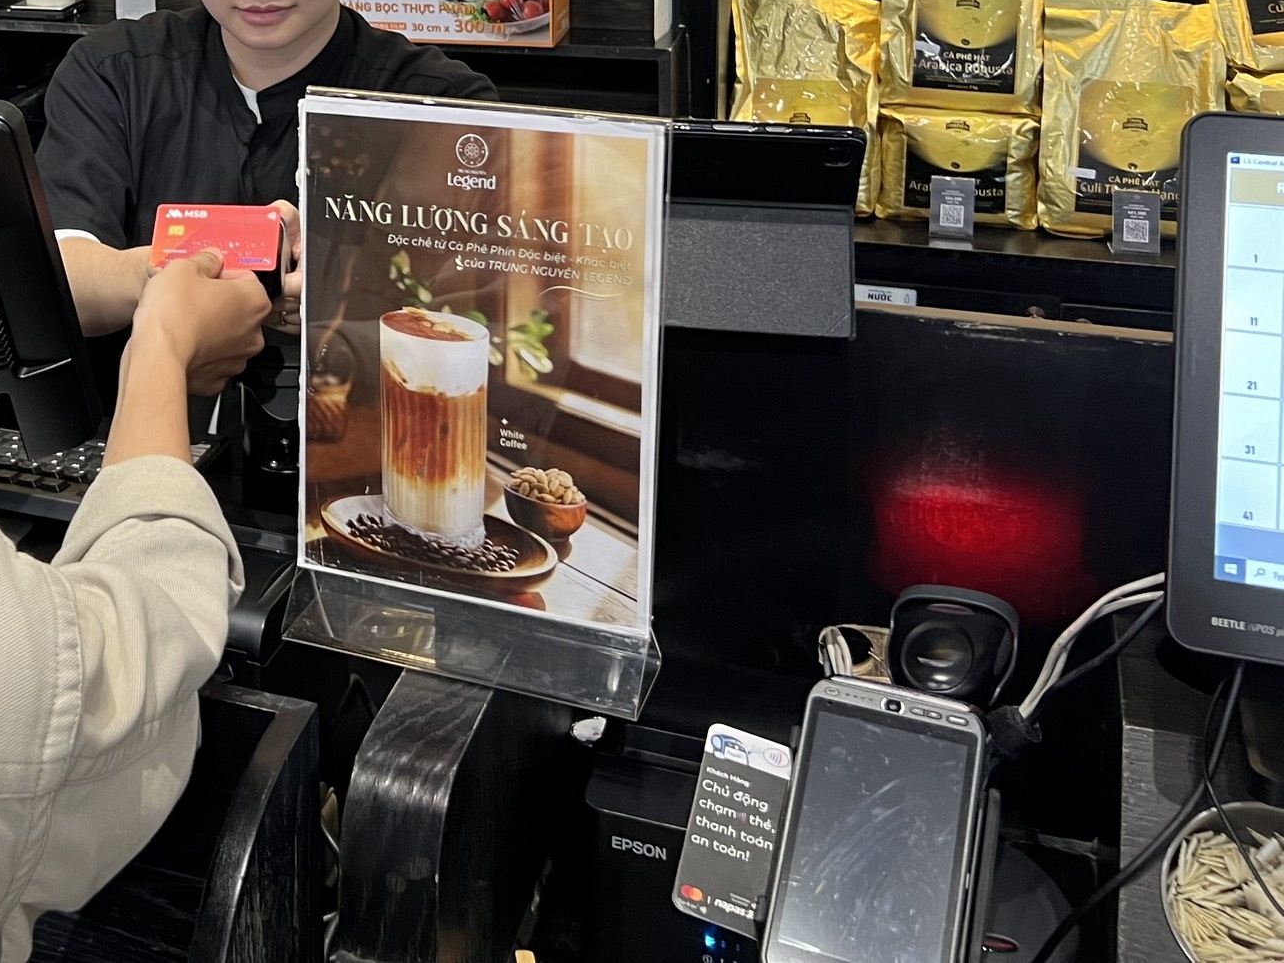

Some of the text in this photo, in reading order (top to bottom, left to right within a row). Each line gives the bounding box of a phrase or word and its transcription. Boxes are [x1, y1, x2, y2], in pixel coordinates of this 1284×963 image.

[375, 3, 399, 15] BỌC
[402, 2, 435, 15] THỰC
[411, 23, 424, 32] 30
[454, 20, 484, 33] 300
[490, 23, 506, 34] m
[918, 58, 1013, 76] Arabica Robusta
[447, 172, 496, 190] Legend
[1080, 182, 1101, 193] Culi
[183, 209, 208, 218] MSB
[325, 193, 633, 253] NĂNG LƯỢNG SÁNG TẠO
[387, 233, 631, 272] Đặc chế từ Cà Phê Phin Đặc biệt Khác biệt
[1253, 254, 1258, 263] 1
[464, 257, 632, 286] của TRUNG NGUYÊN LEGEND
[1250, 317, 1258, 326] 11
[1247, 381, 1257, 390] 21
[500, 428, 525, 441] White
[499, 437, 528, 451] Coffee
[1245, 445, 1255, 455] 31
[1243, 511, 1253, 521] 41
[1211, 617, 1246, 631] BEETLE
[706, 766, 728, 779] Khách
[702, 779, 768, 813] Chủ động
[699, 798, 737, 819] chạm
[695, 814, 773, 851] thanh toán
[611, 835, 667, 861] EPSON
[691, 834, 750, 862] an toàn!
